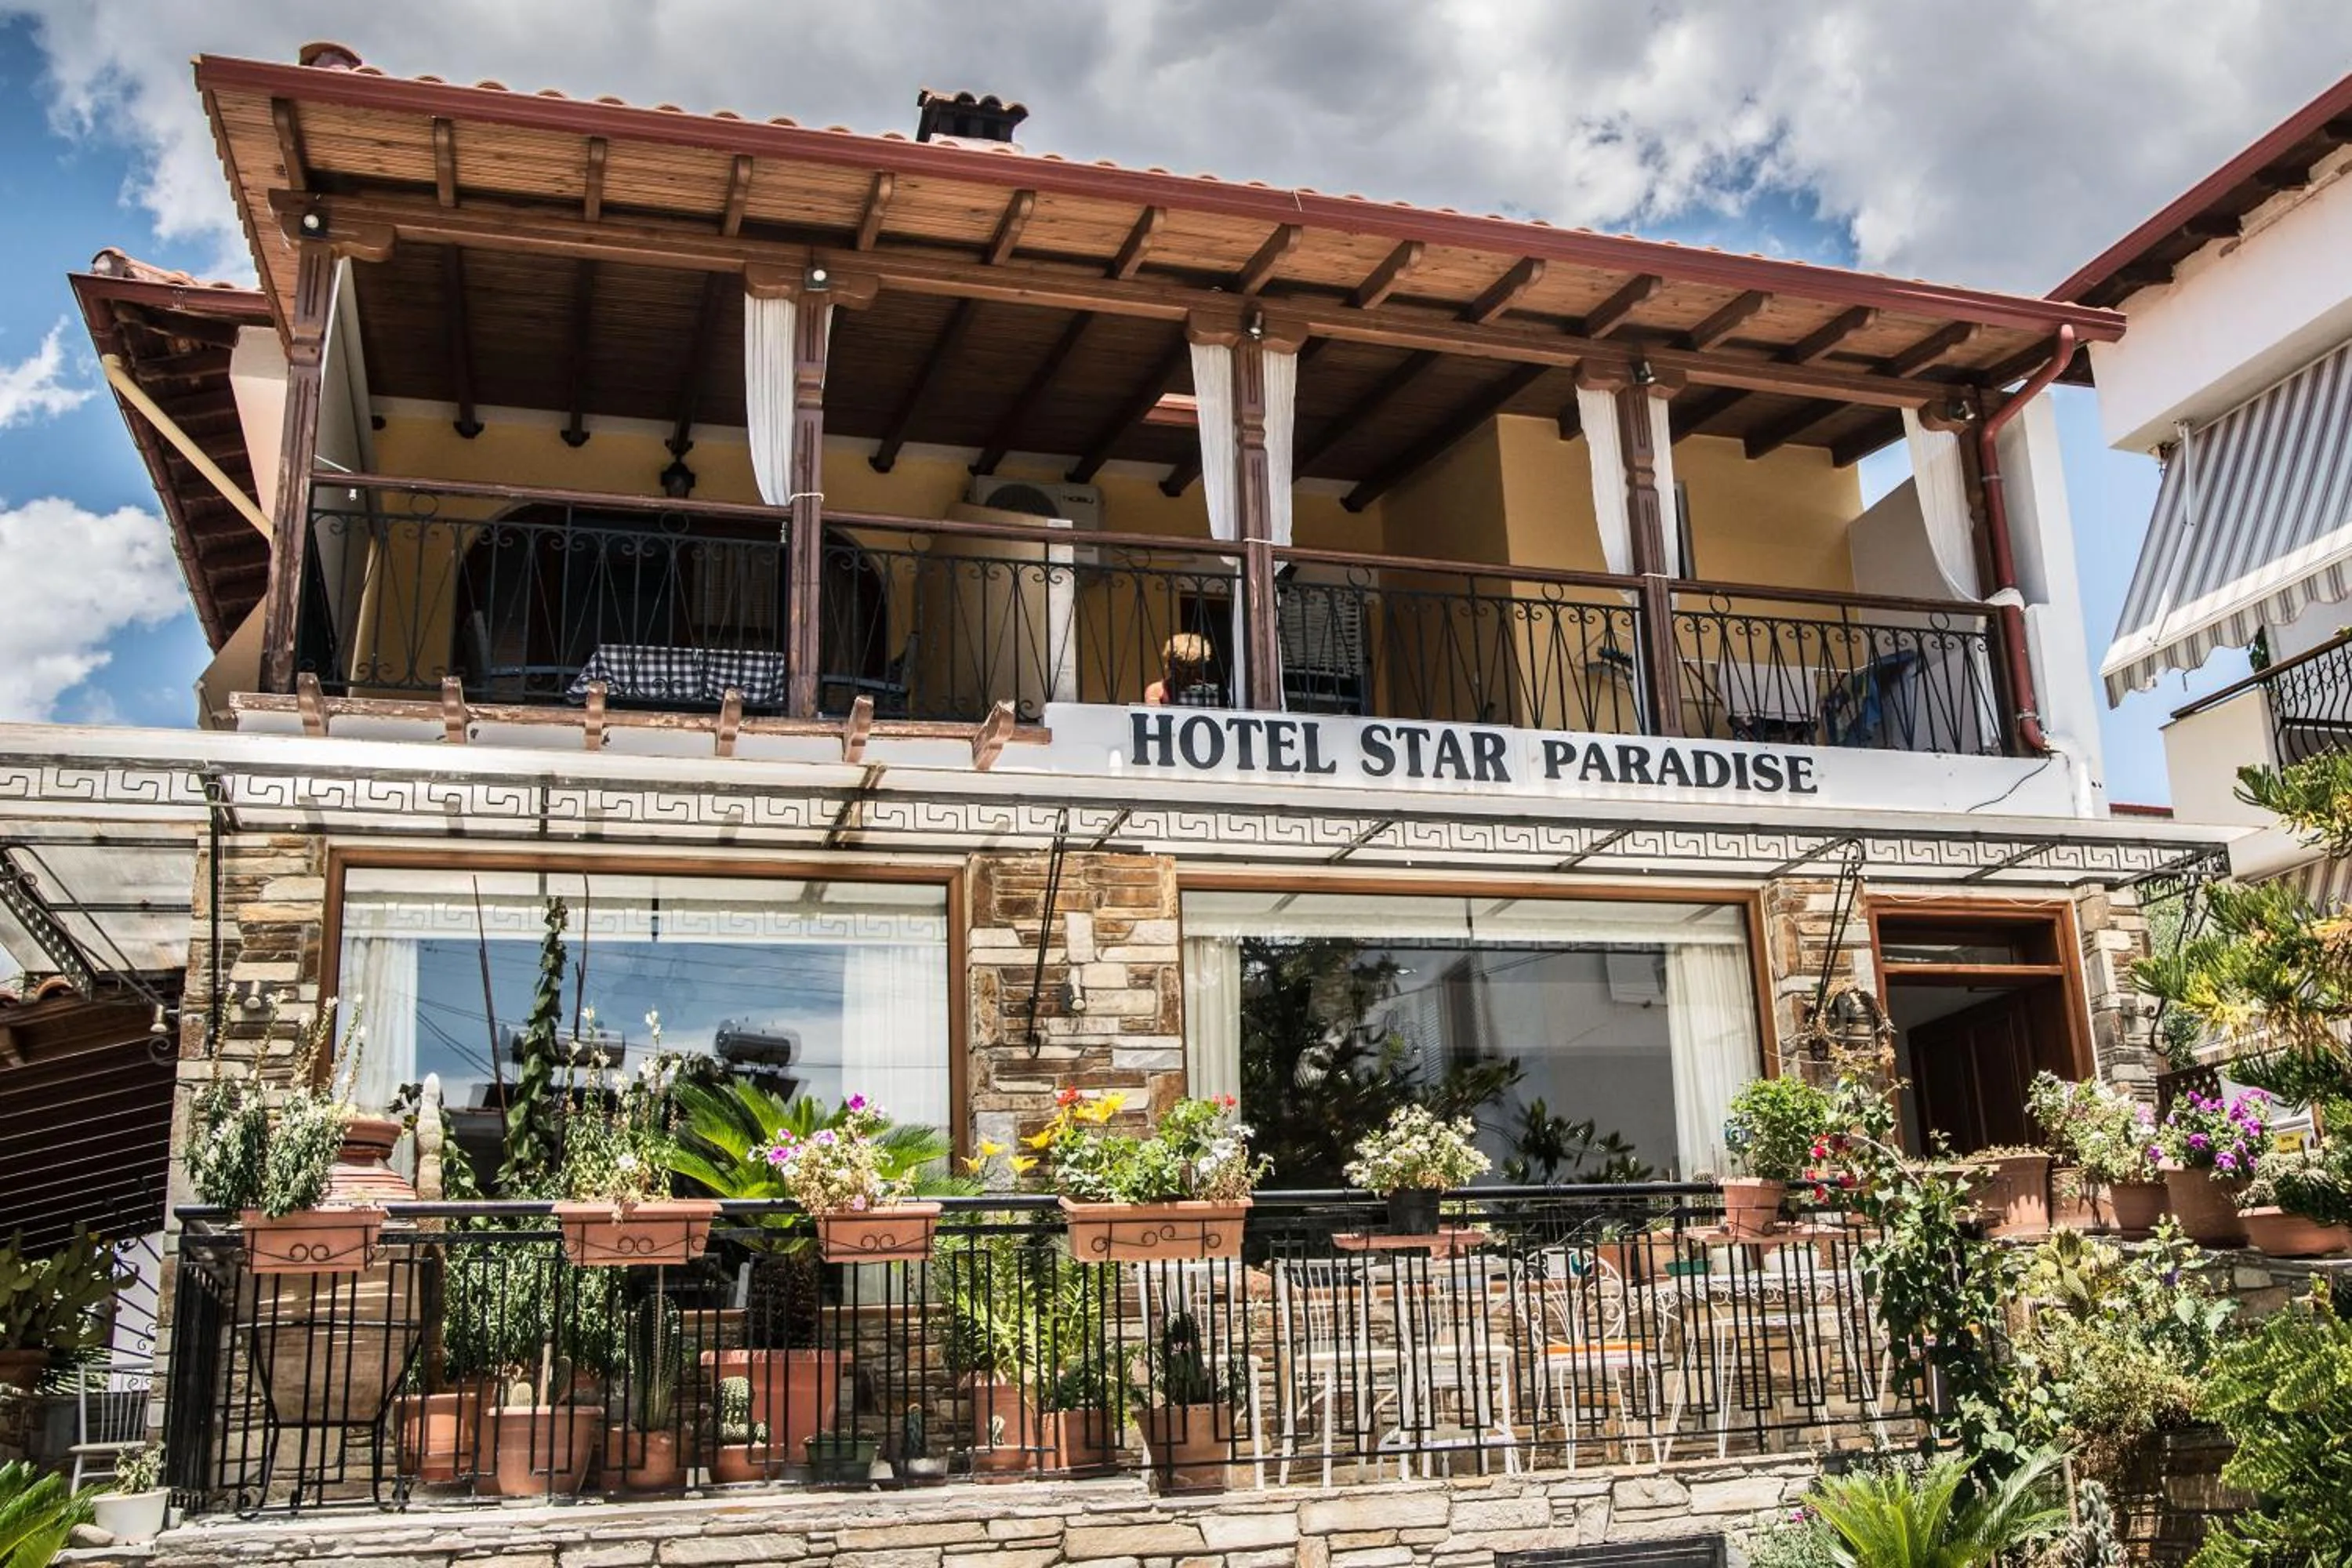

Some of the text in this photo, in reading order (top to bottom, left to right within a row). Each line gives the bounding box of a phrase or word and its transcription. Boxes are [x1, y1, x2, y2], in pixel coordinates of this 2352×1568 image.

[1131, 713, 1817, 793] HOTEL STAR PARADISE
